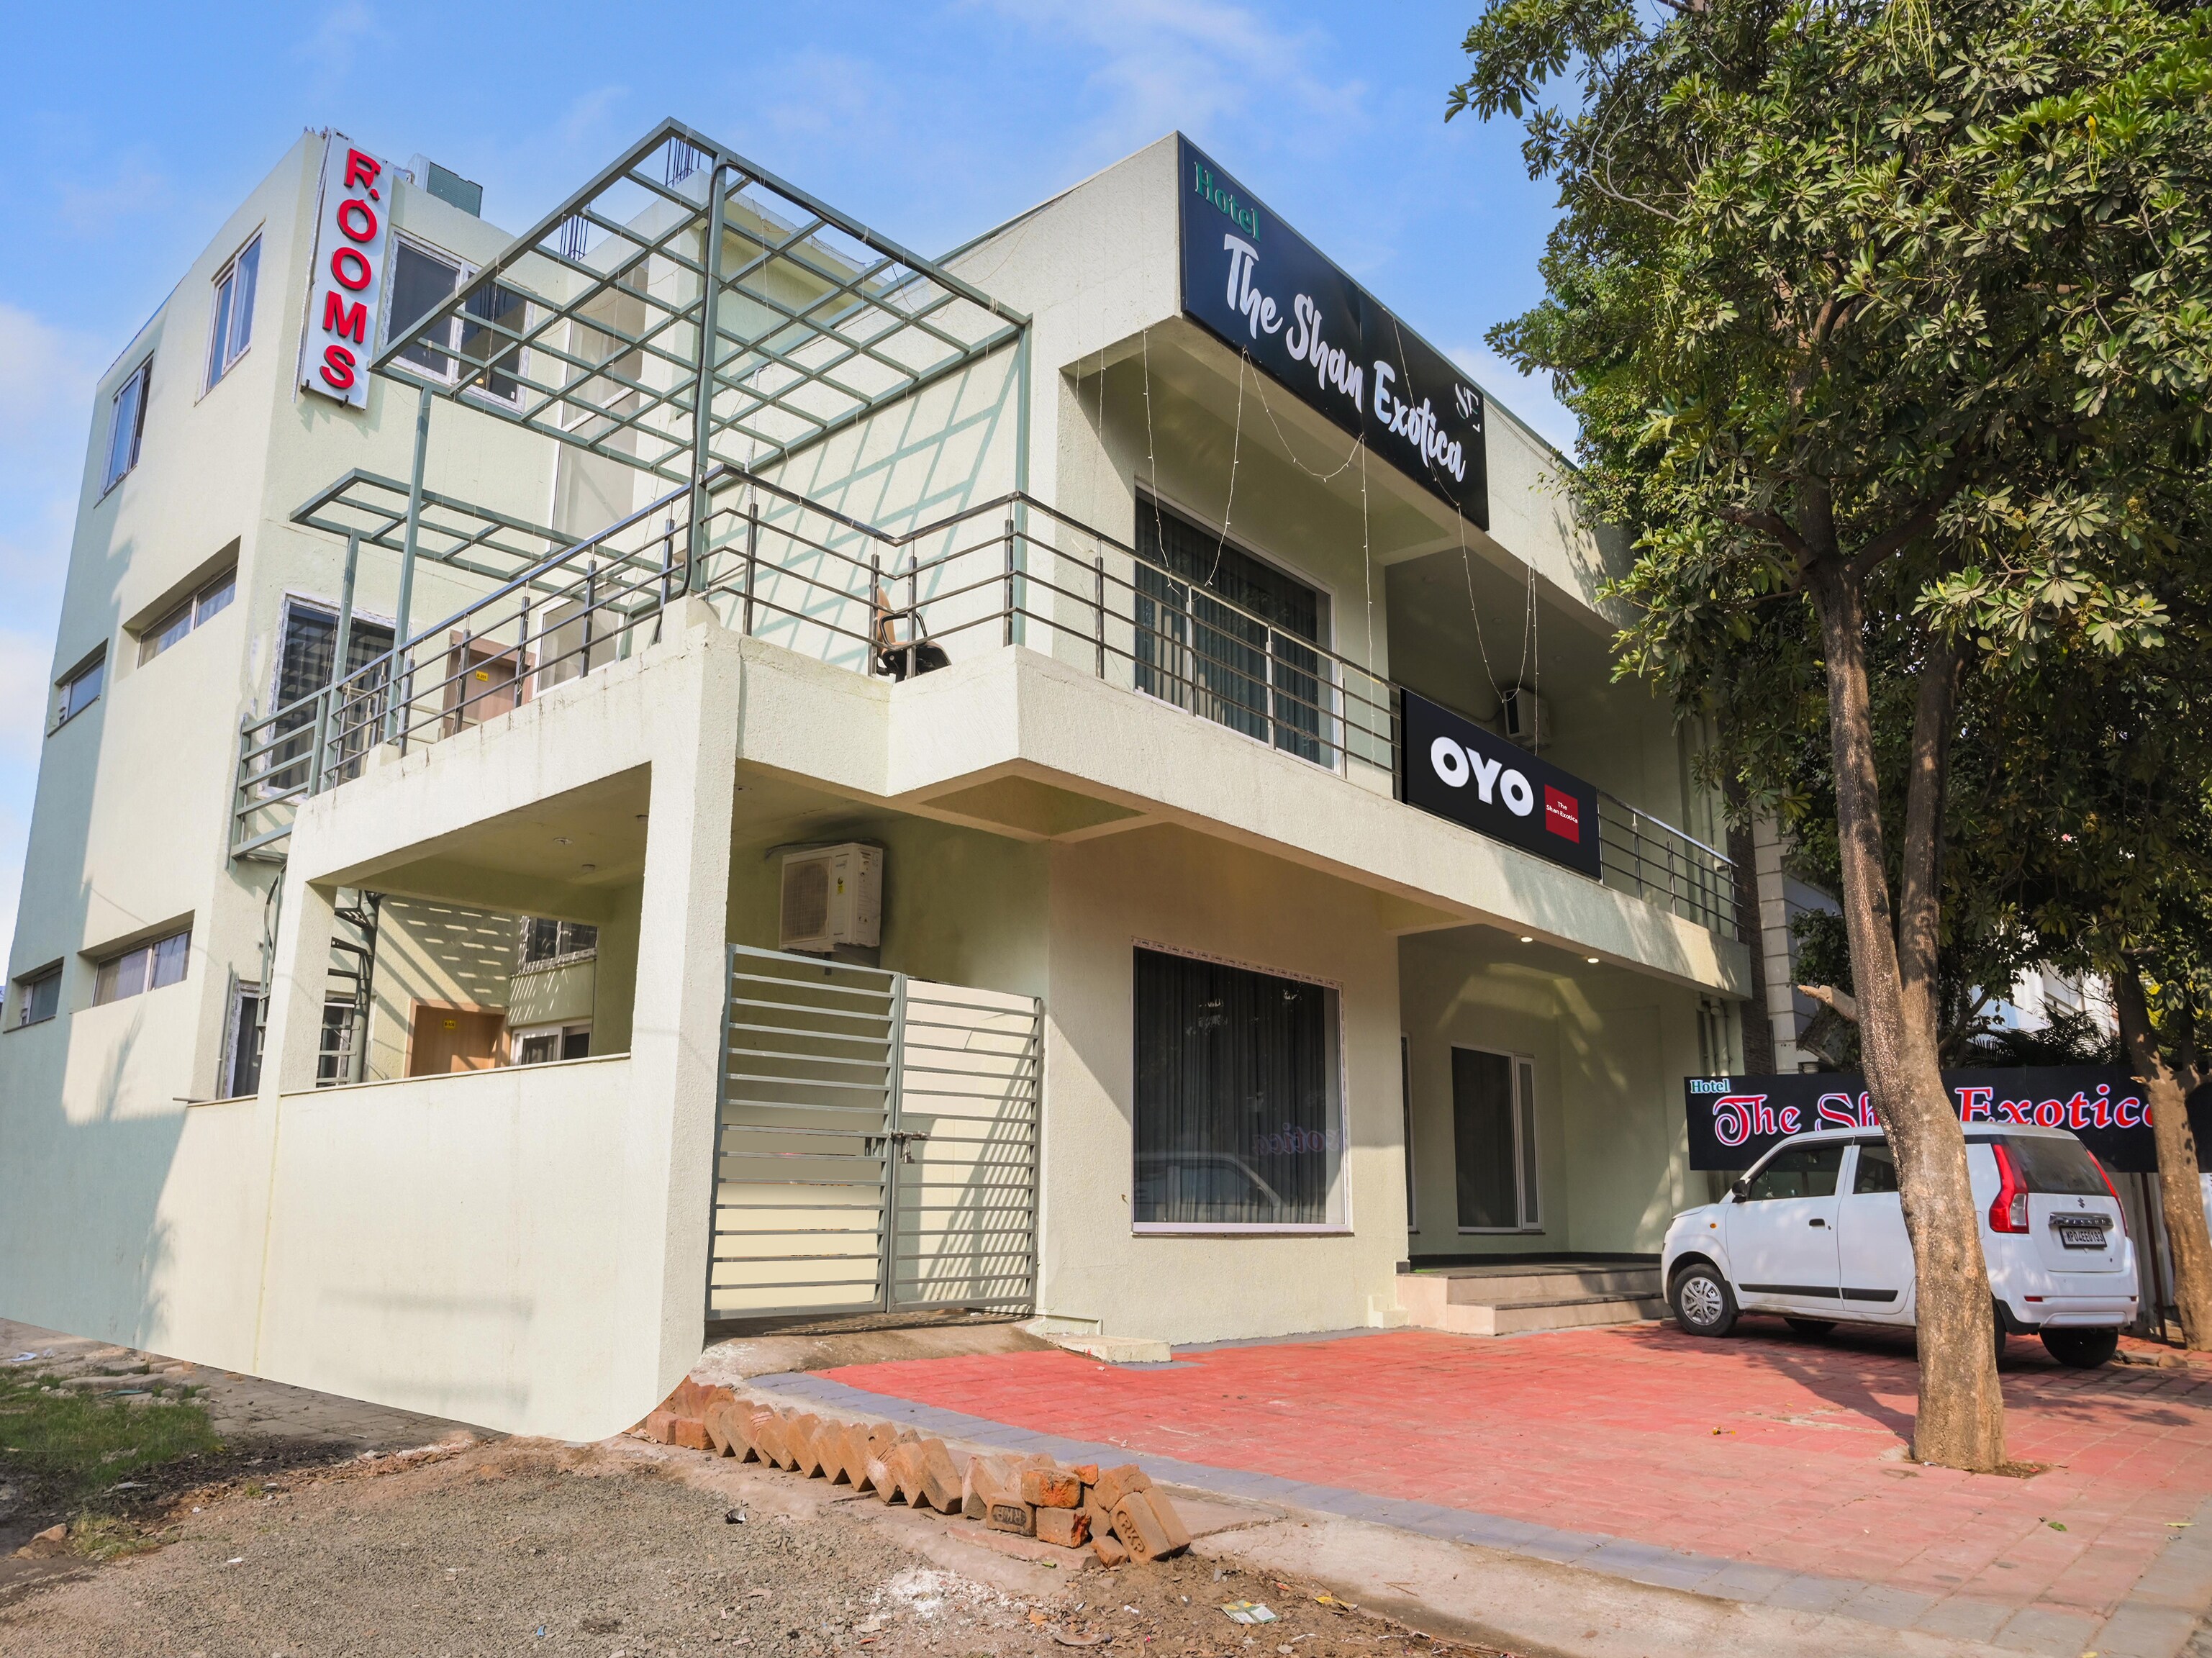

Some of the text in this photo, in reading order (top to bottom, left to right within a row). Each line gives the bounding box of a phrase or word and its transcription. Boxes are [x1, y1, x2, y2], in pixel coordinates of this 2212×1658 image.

[1194, 161, 1261, 243] Hotel
[1224, 233, 1466, 482] The Shan Exotica
[1431, 736, 1533, 816] OYO
[1546, 805, 1578, 823] Shan Exotica
[1557, 801, 1567, 810] The
[1690, 1079, 1731, 1094] Hotel
[1713, 1094, 1801, 1146] The
[1815, 1091, 1881, 1131] Sh
[1120, 1519, 1146, 1553] RKP
